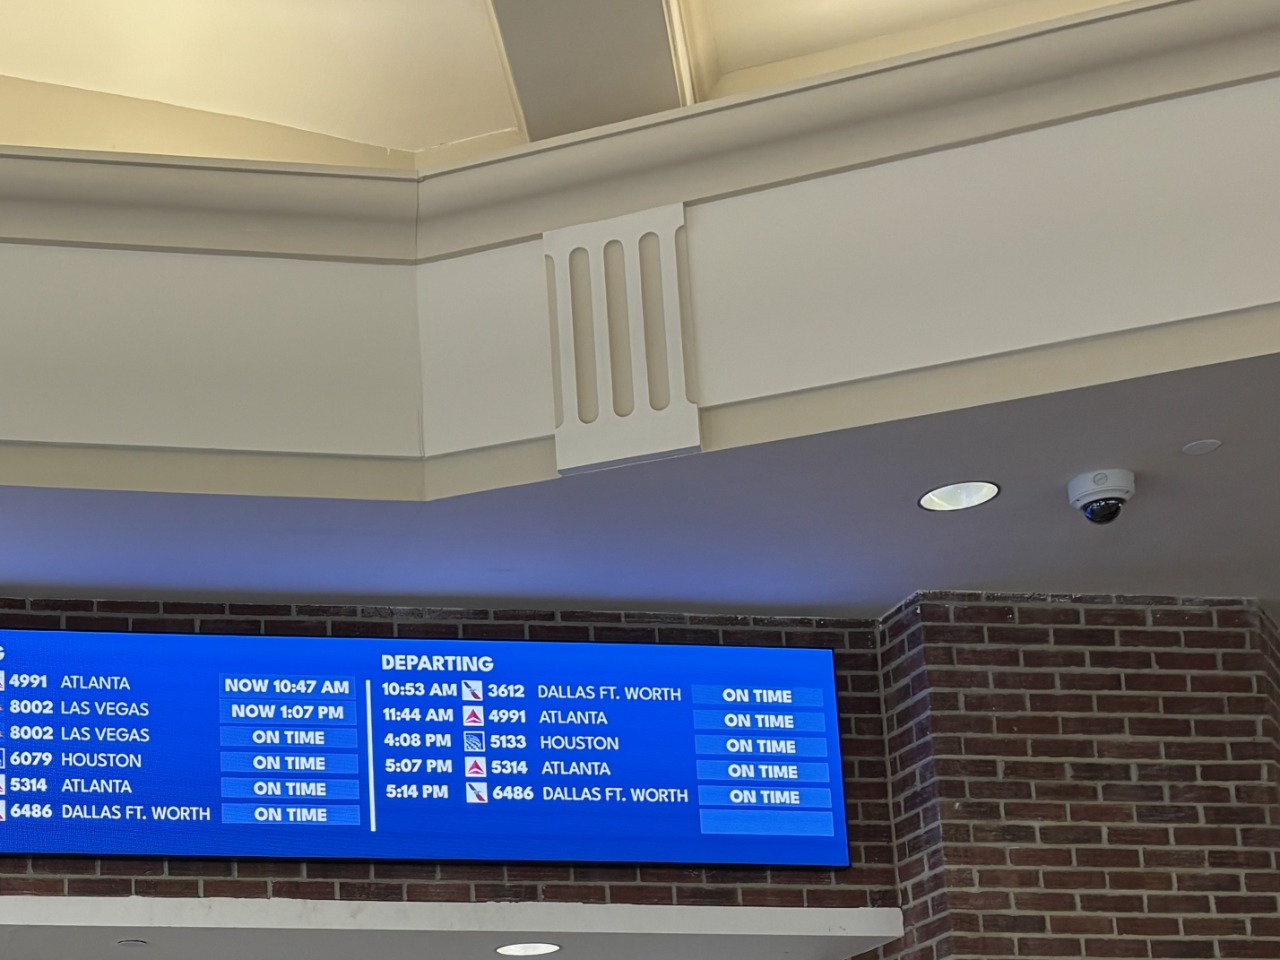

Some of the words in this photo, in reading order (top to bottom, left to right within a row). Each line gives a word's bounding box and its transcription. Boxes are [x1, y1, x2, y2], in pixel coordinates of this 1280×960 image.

[382, 655, 494, 671] DEPARTING
[9, 674, 47, 689] 4991
[60, 675, 130, 690] ATLANTA
[225, 678, 269, 693] NOW
[274, 679, 316, 694] 10:47
[320, 680, 349, 694] AM
[382, 682, 424, 696] 10:53
[430, 683, 457, 697] AM
[488, 684, 525, 698] 3612
[538, 685, 596, 700] DALLAS
[600, 686, 620, 700] FT.
[624, 687, 681, 701] WORTH
[722, 689, 750, 703] ON
[754, 689, 792, 703] TIME
[9, 700, 53, 714] 8002
[61, 701, 91, 716] LAS
[95, 701, 149, 717] VEGAS
[231, 704, 275, 719] NOW
[280, 705, 315, 719] 1:07
[319, 705, 344, 719] PM
[383, 708, 421, 722] 11:44
[425, 708, 454, 722] AM
[489, 710, 526, 723] 4991
[539, 710, 608, 725] ATLANTA
[724, 713, 751, 728] ON
[755, 714, 794, 728] TIME
[10, 726, 54, 740] 8002
[61, 727, 92, 742] LAS
[96, 727, 150, 742] VEGAS
[252, 730, 279, 745] ON
[284, 731, 325, 745] TIME
[384, 733, 421, 747] 4:08
[426, 734, 451, 748] PM
[490, 735, 526, 749] 5133
[540, 735, 619, 750] HOUSTON
[726, 739, 753, 753] ON
[757, 739, 796, 753] TIME
[9, 752, 52, 766] 6079
[62, 753, 141, 768] HOUSTON
[253, 756, 280, 770] ON
[285, 756, 325, 770] TIME
[385, 759, 422, 773] 5:07
[426, 760, 453, 773] PM
[491, 760, 528, 775] 5314
[541, 761, 611, 775] ATLANTA
[728, 764, 755, 778] ON
[759, 765, 798, 779] TIME
[10, 778, 47, 792] 5314
[61, 779, 132, 794] ATLANTA
[254, 781, 281, 796] ON
[286, 782, 326, 796] TIME
[386, 784, 417, 798] 5:14
[422, 785, 448, 798] PM
[493, 786, 533, 800] 6486
[543, 787, 601, 801] DALLAS
[605, 787, 626, 801] FT.
[630, 788, 688, 803] WORTH
[730, 789, 757, 804] ON
[761, 790, 800, 804] TIME
[10, 804, 52, 818] 6486
[62, 805, 121, 820] DALLAS
[126, 806, 148, 820] FT.
[152, 806, 211, 821] WORTH
[254, 807, 282, 822] ON
[286, 808, 327, 822] TIME
